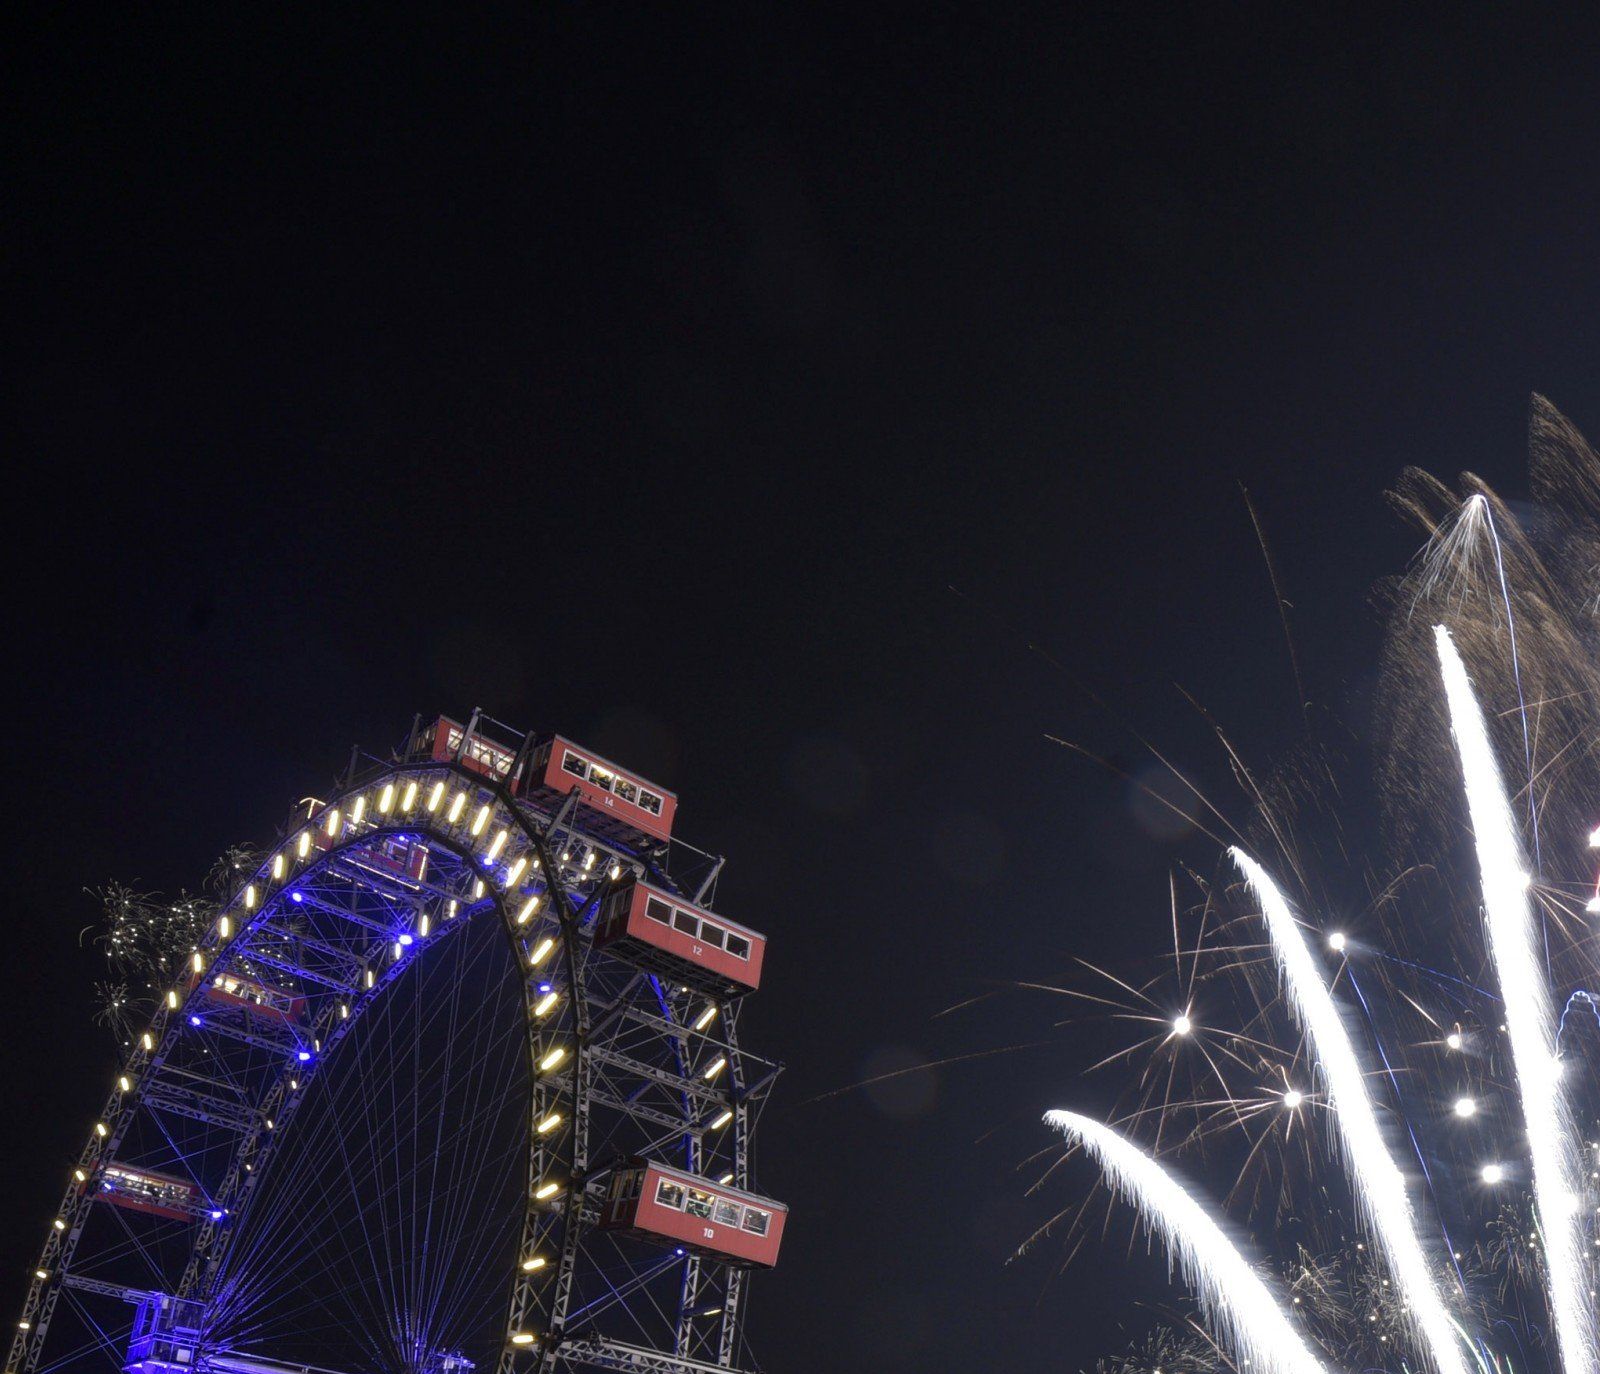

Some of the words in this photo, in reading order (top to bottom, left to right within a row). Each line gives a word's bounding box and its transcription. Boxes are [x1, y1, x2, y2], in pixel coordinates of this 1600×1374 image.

[604, 796, 614, 807] 14
[692, 945, 703, 956] 12
[703, 1227, 714, 1239] 10
